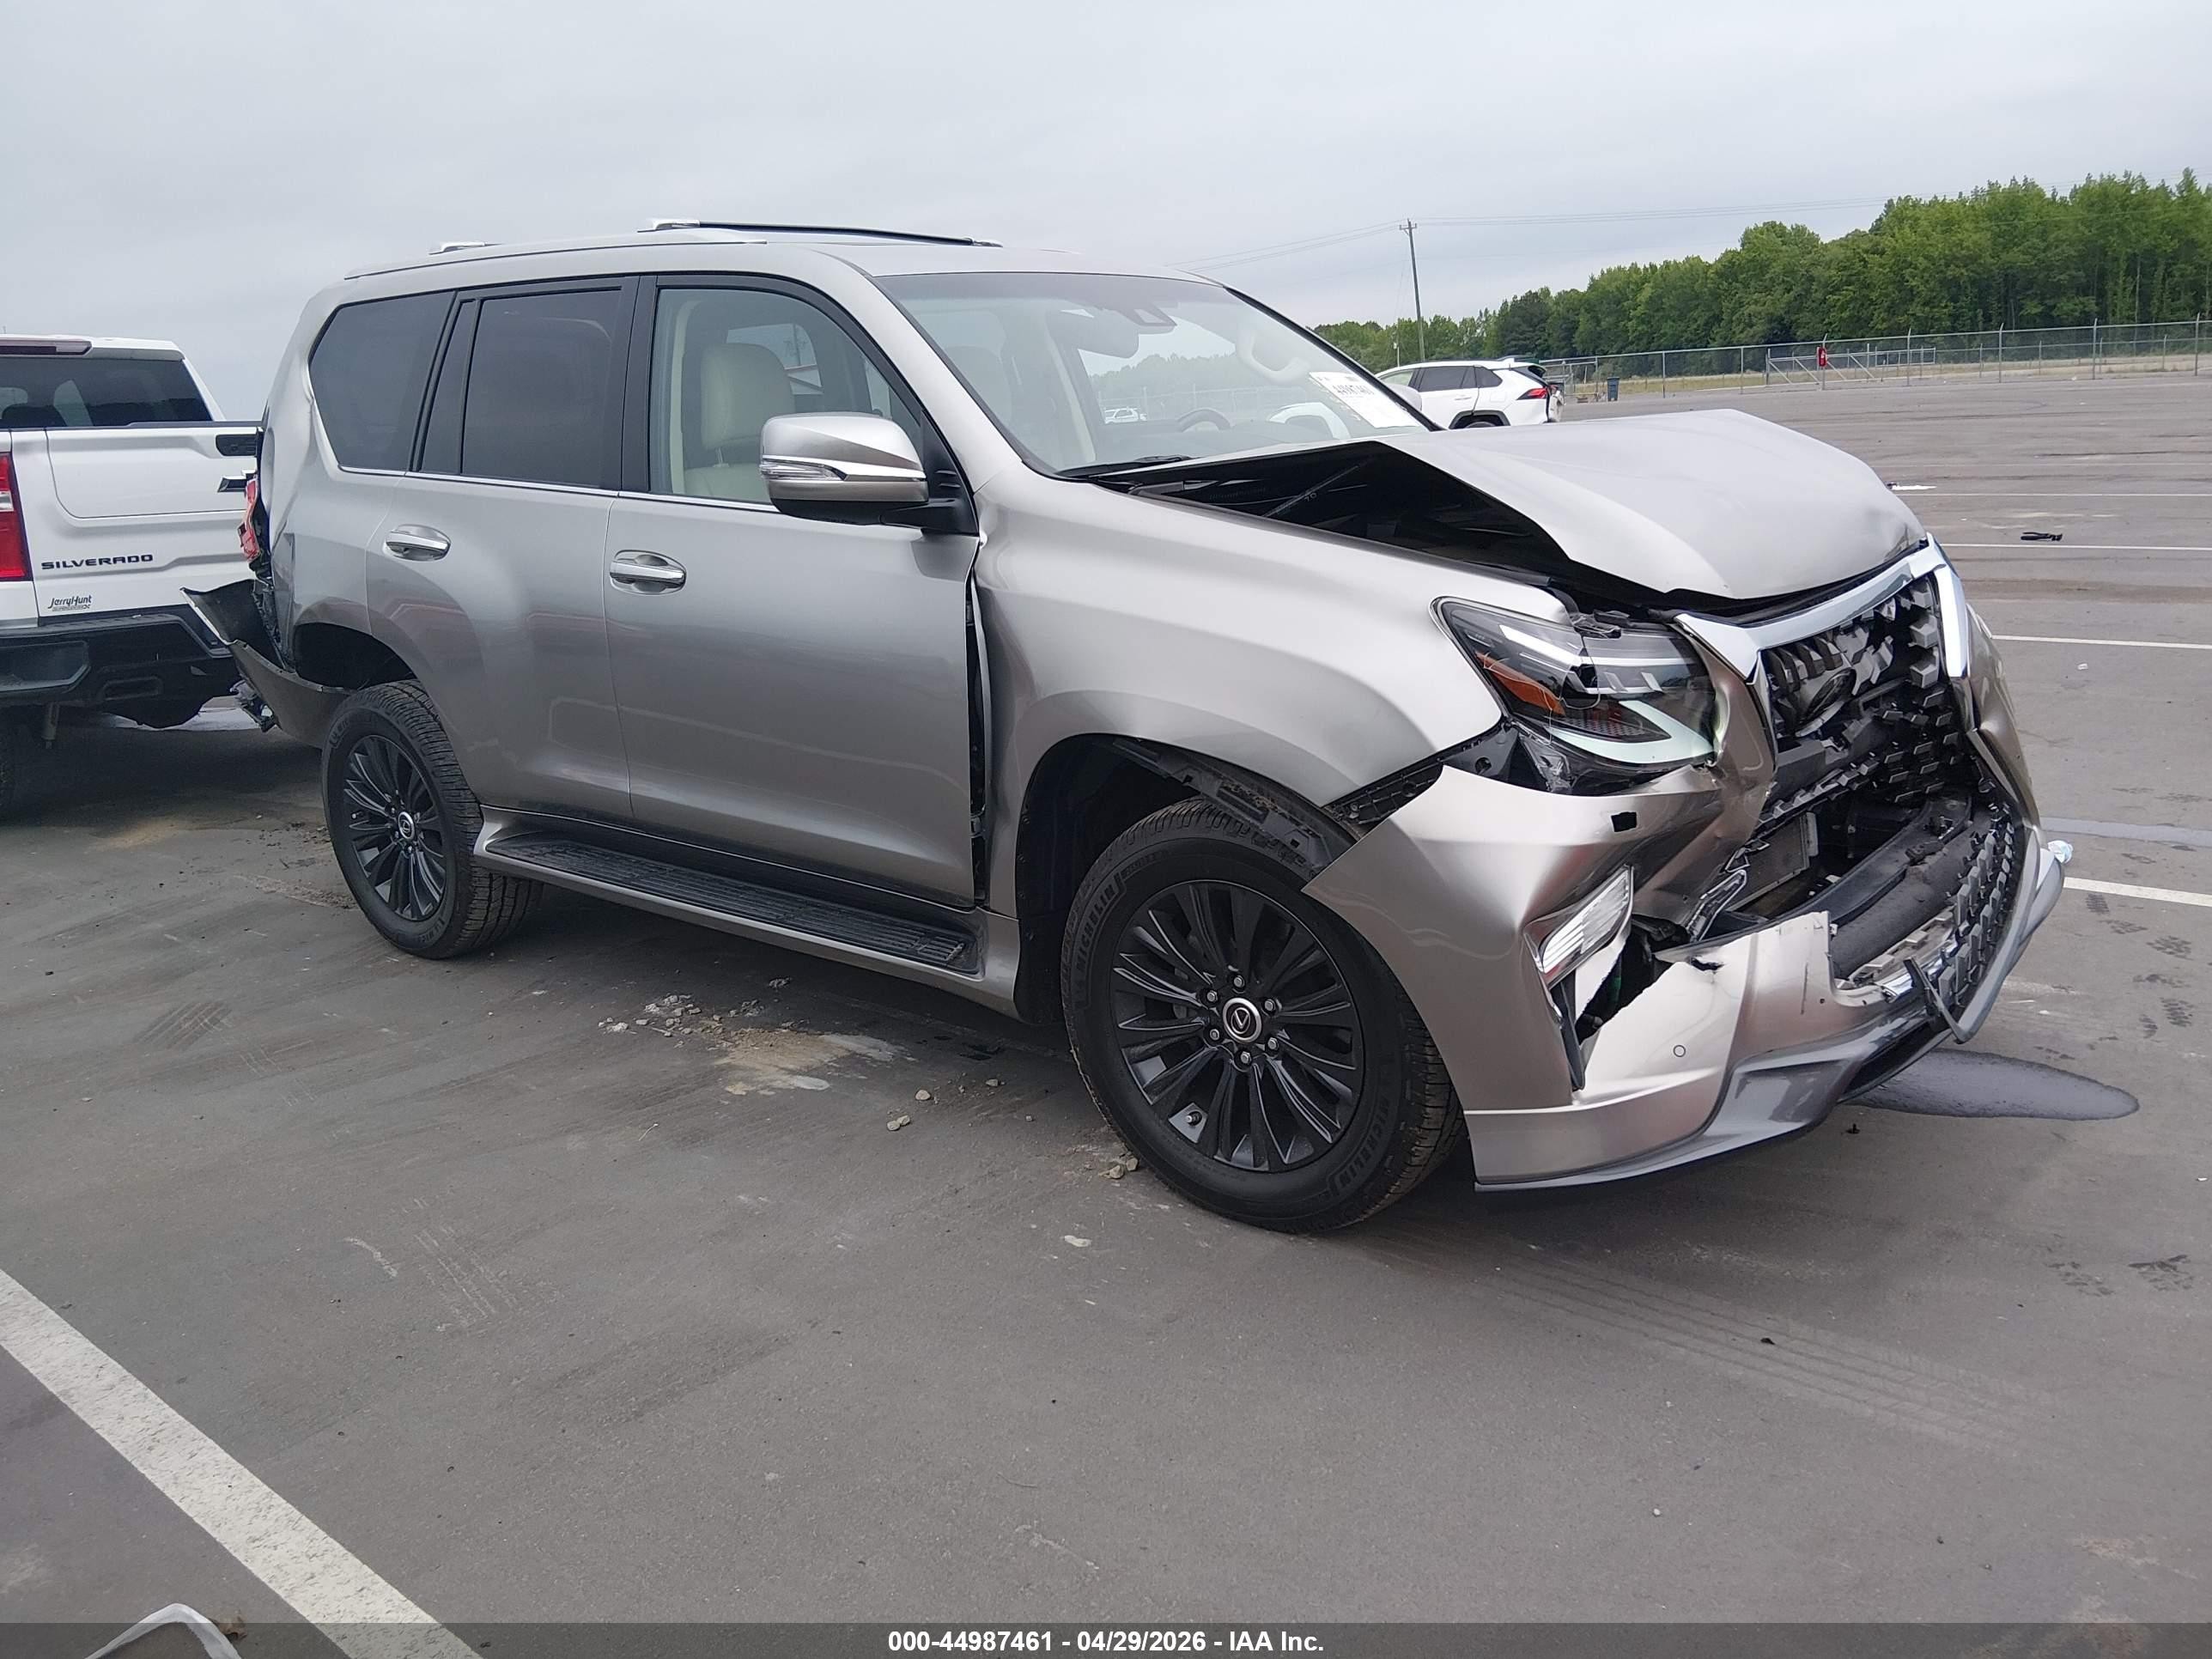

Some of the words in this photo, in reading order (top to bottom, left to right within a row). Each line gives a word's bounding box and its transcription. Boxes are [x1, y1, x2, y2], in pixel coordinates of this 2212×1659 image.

[40, 554, 154, 570] SILVERADO
[1076, 884, 1115, 973] MICHELIN
[1339, 1095, 1389, 1189] MICHELIN
